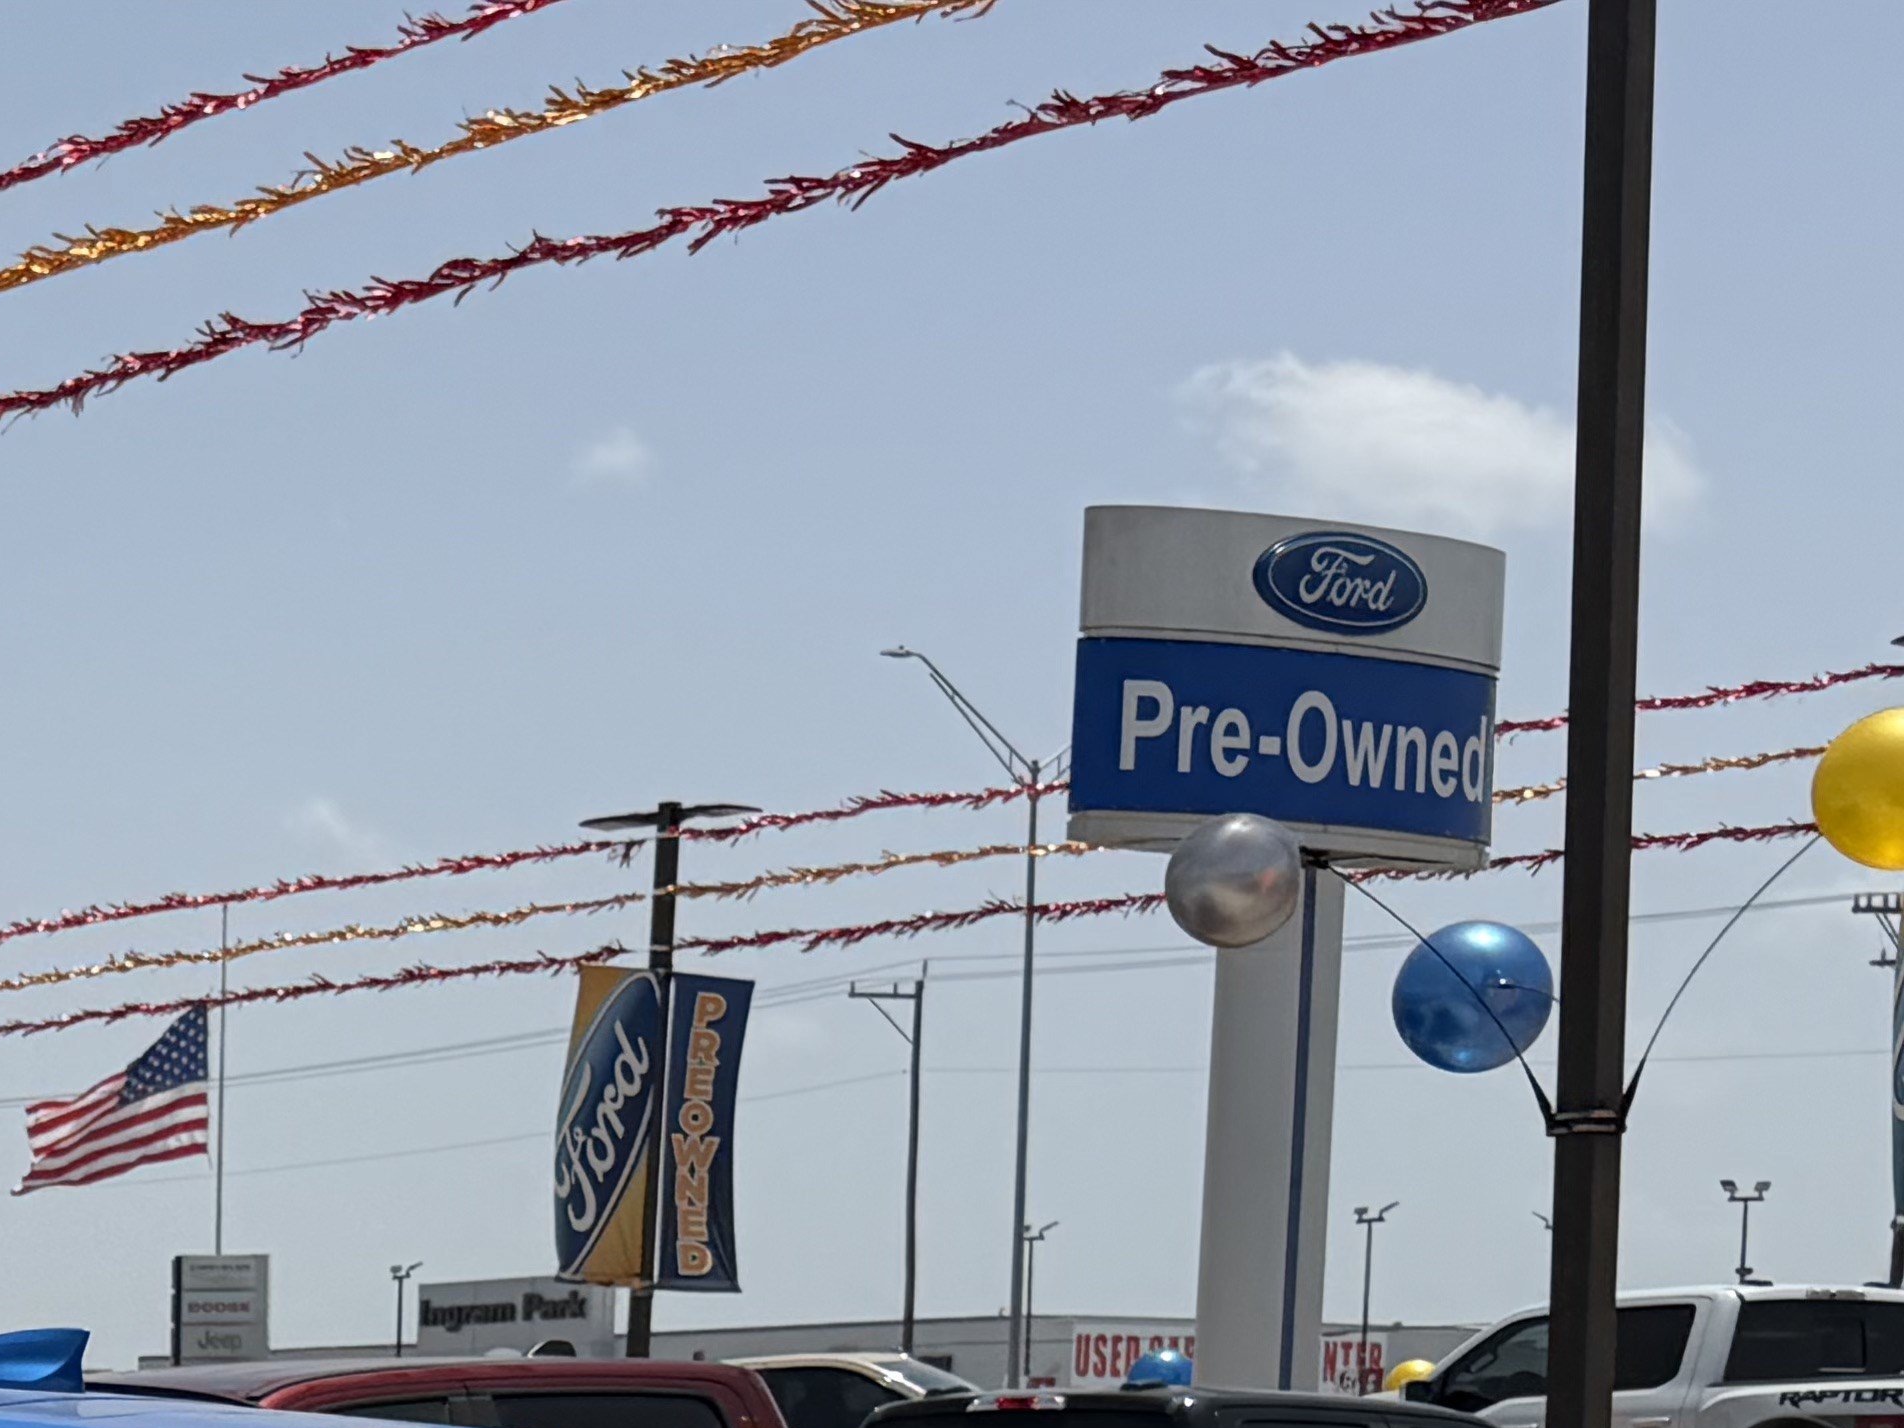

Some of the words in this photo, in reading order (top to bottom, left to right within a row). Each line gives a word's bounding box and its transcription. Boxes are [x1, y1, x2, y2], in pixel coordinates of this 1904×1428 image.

[1298, 545, 1397, 612] Ford
[1118, 678, 1489, 804] Pre-Owned
[555, 1019, 650, 1233] Ford
[671, 991, 728, 1277] PREOWNED
[419, 1298, 517, 1333] Ingram
[521, 1289, 588, 1322] Park
[1074, 1333, 1141, 1378] USED
[1779, 1387, 1904, 1409] RAPTOR
